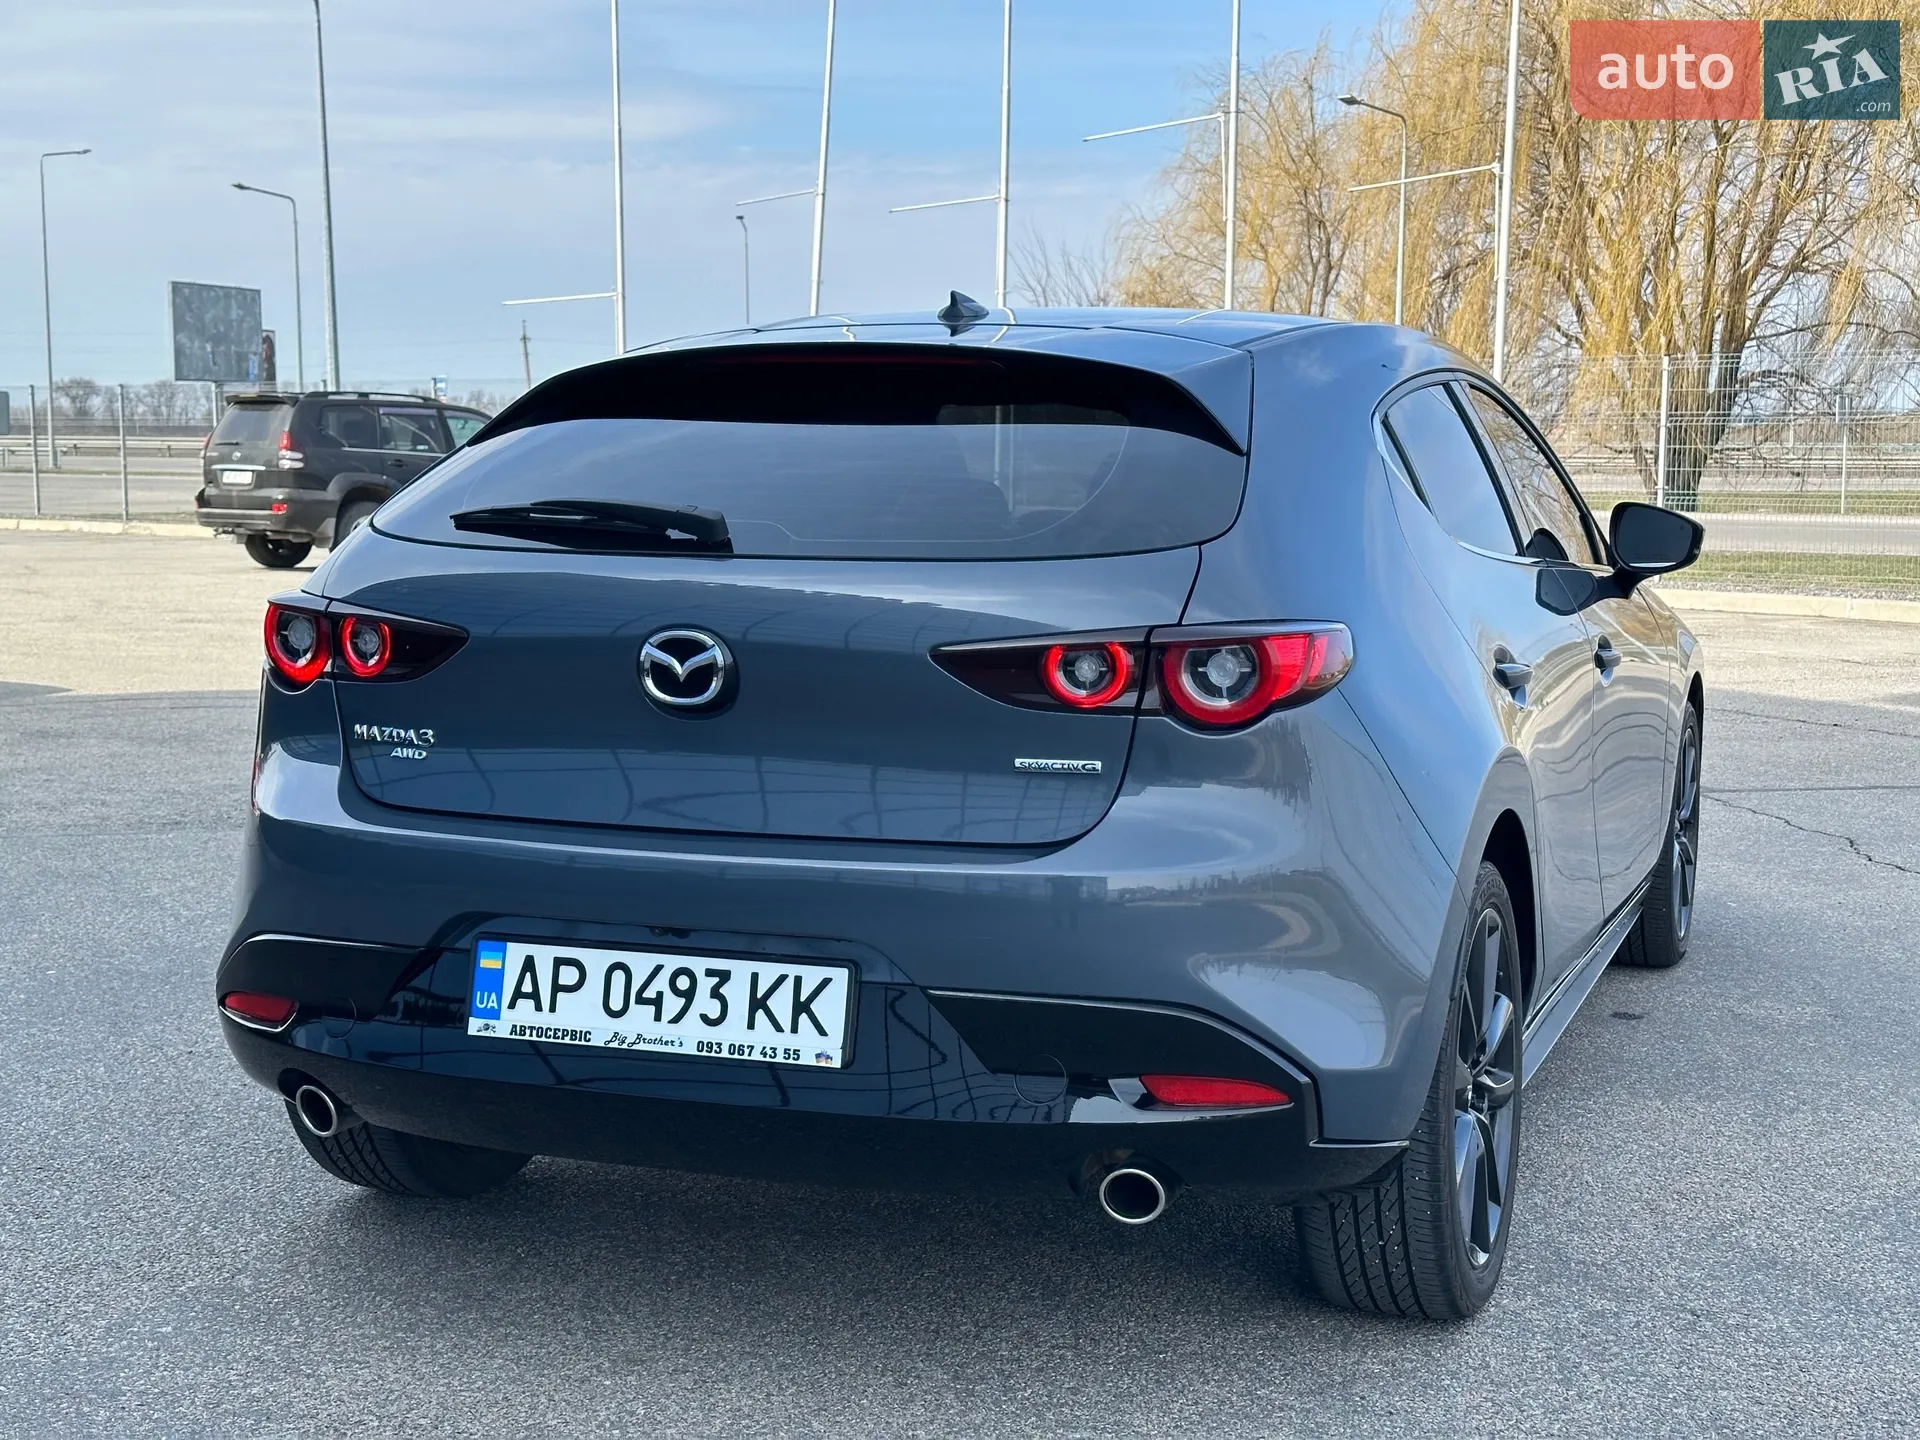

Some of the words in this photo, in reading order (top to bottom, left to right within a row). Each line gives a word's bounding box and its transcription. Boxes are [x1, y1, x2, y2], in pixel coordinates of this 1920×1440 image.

[354, 724, 434, 747] MAZDA3
[390, 748, 427, 759] AWD
[476, 991, 498, 1009] UA
[507, 954, 587, 1013] AP
[602, 961, 731, 1027] 0493
[747, 972, 834, 1036] KK
[509, 1024, 592, 1043] АВТОСЕРВІС
[604, 1031, 627, 1046] Big
[696, 1040, 723, 1054] 093
[727, 1043, 755, 1057] 067
[759, 1046, 777, 1060] 43
[782, 1048, 801, 1062] 55
